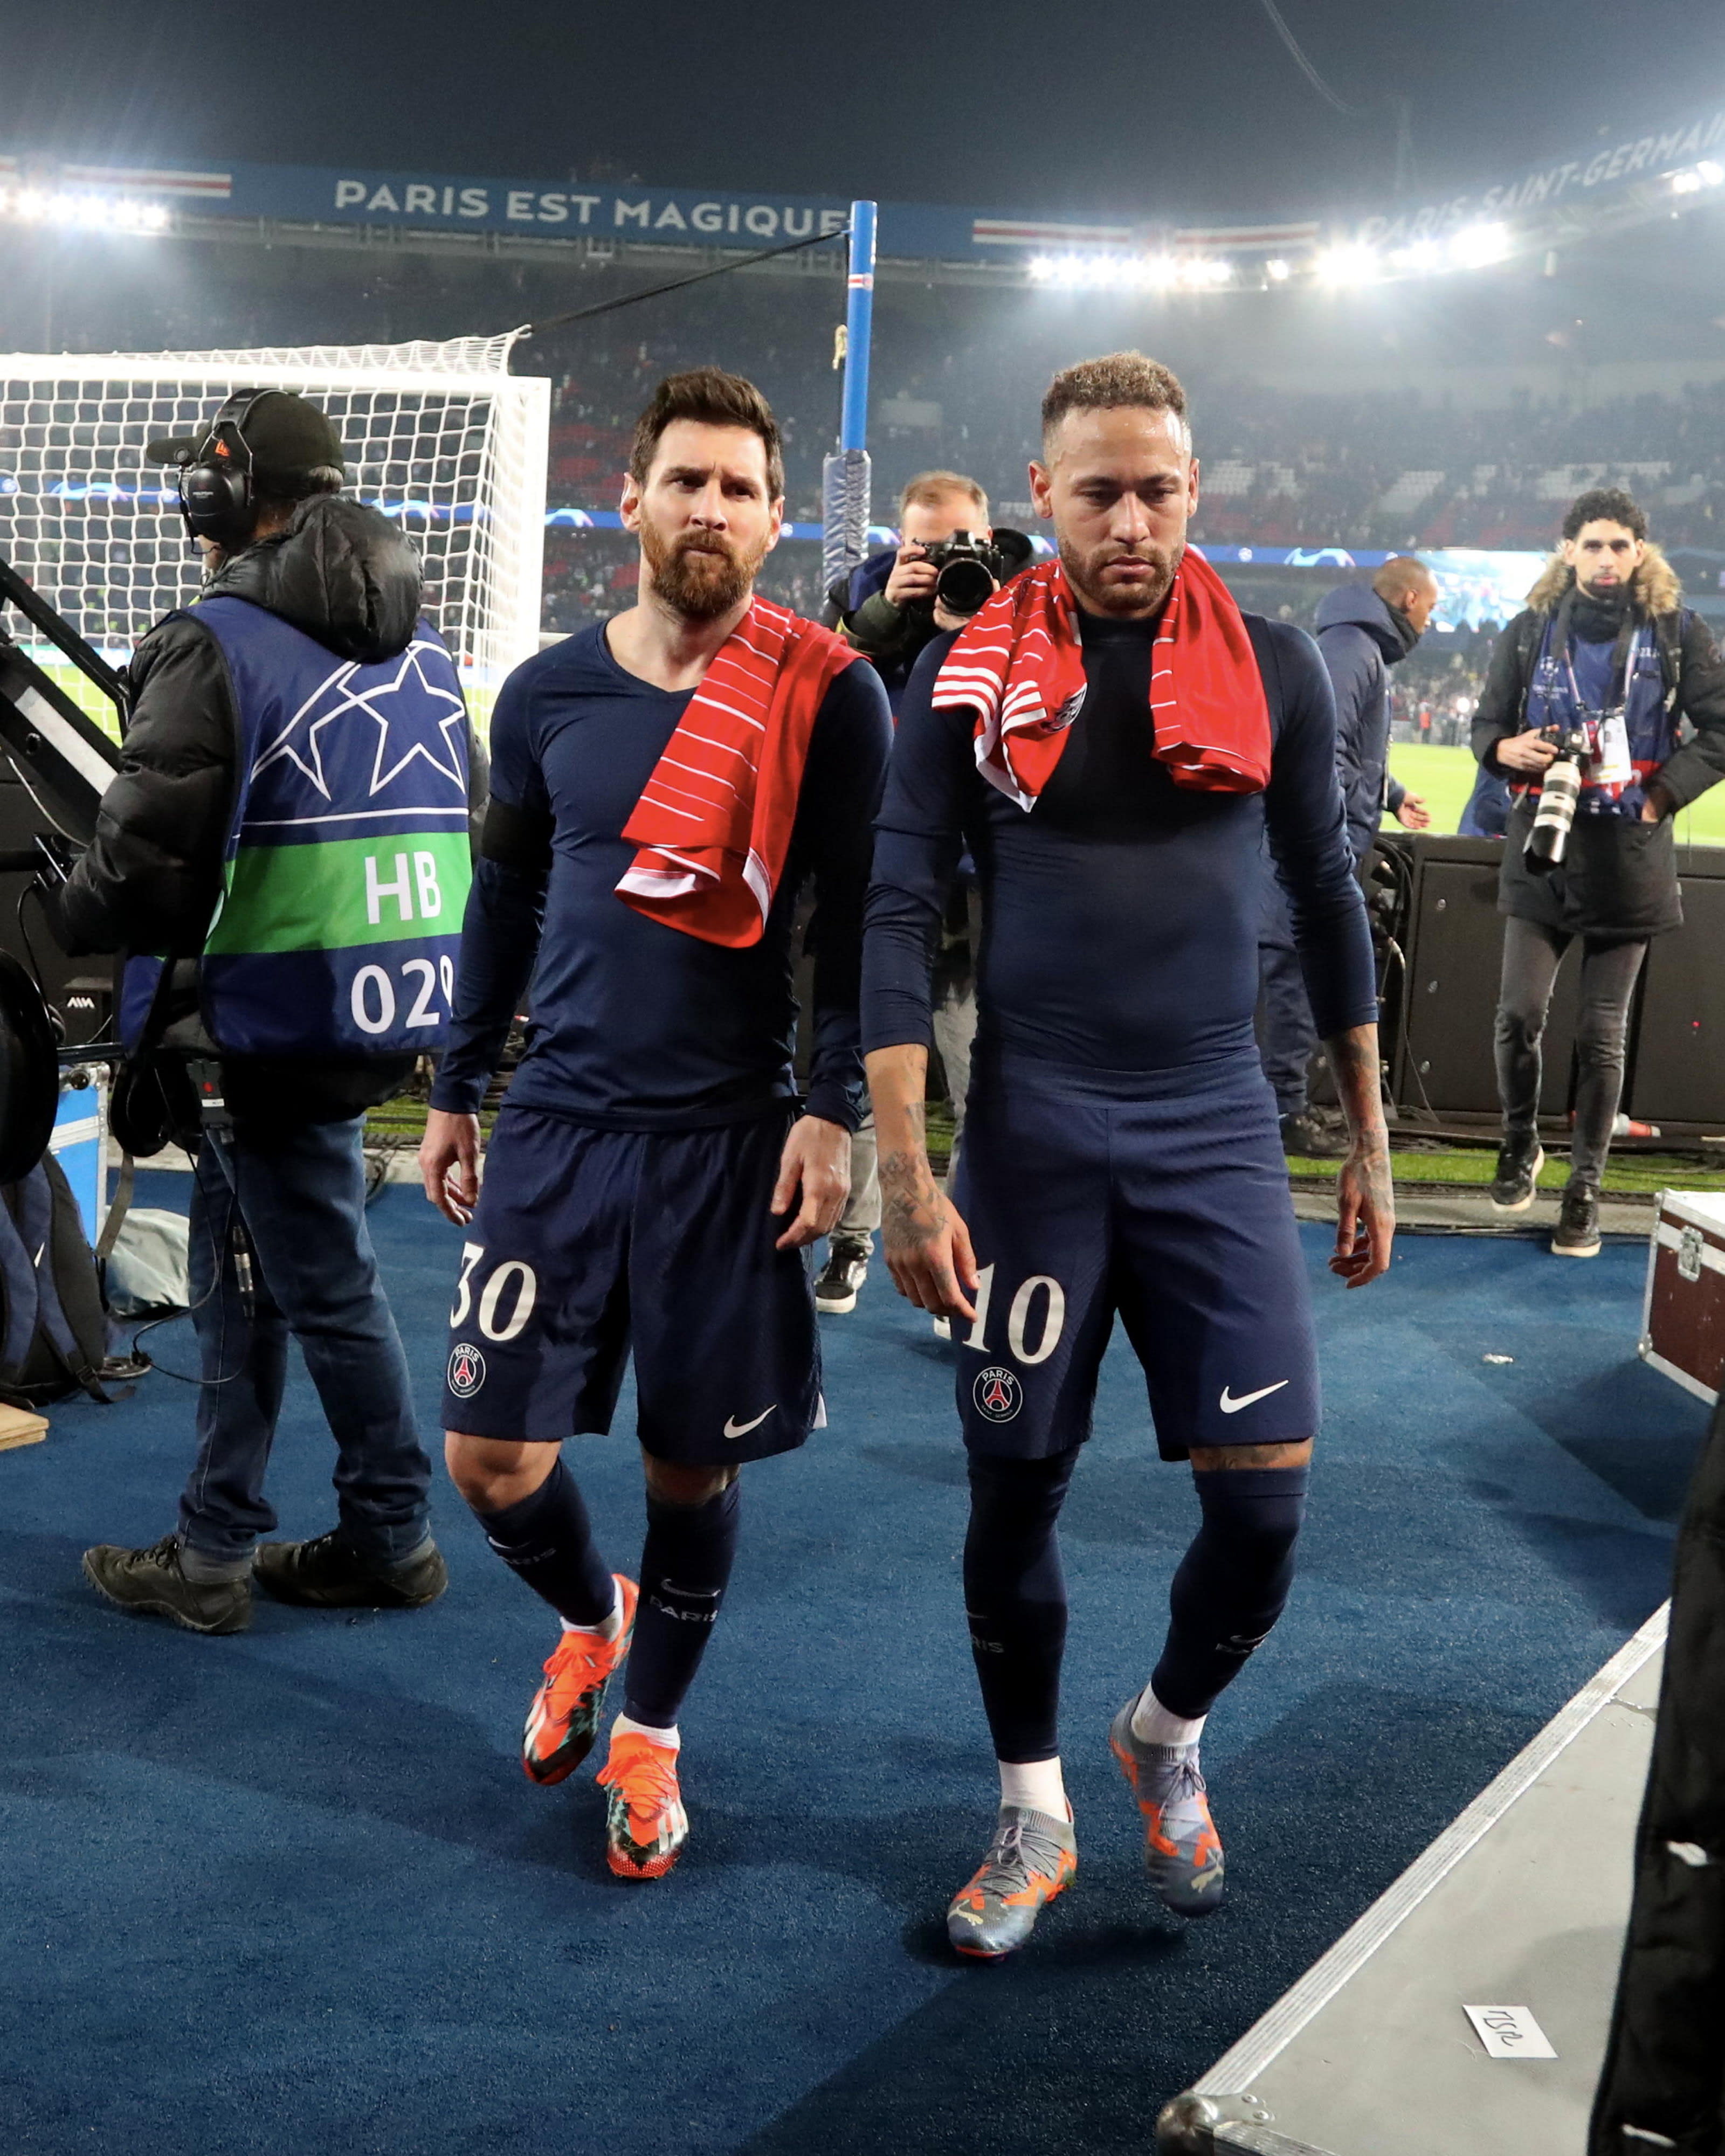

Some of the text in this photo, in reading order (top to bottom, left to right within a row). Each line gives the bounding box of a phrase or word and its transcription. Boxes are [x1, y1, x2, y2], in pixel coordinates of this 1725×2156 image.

[334, 179, 848, 238] PARIS EST MAGIQUE
[364, 851, 442, 925] HB
[450, 1241, 537, 1342] 30
[962, 1262, 1065, 1364] 10
[454, 1346, 479, 1363] PARIS
[982, 1370, 1014, 1385] PARIS
